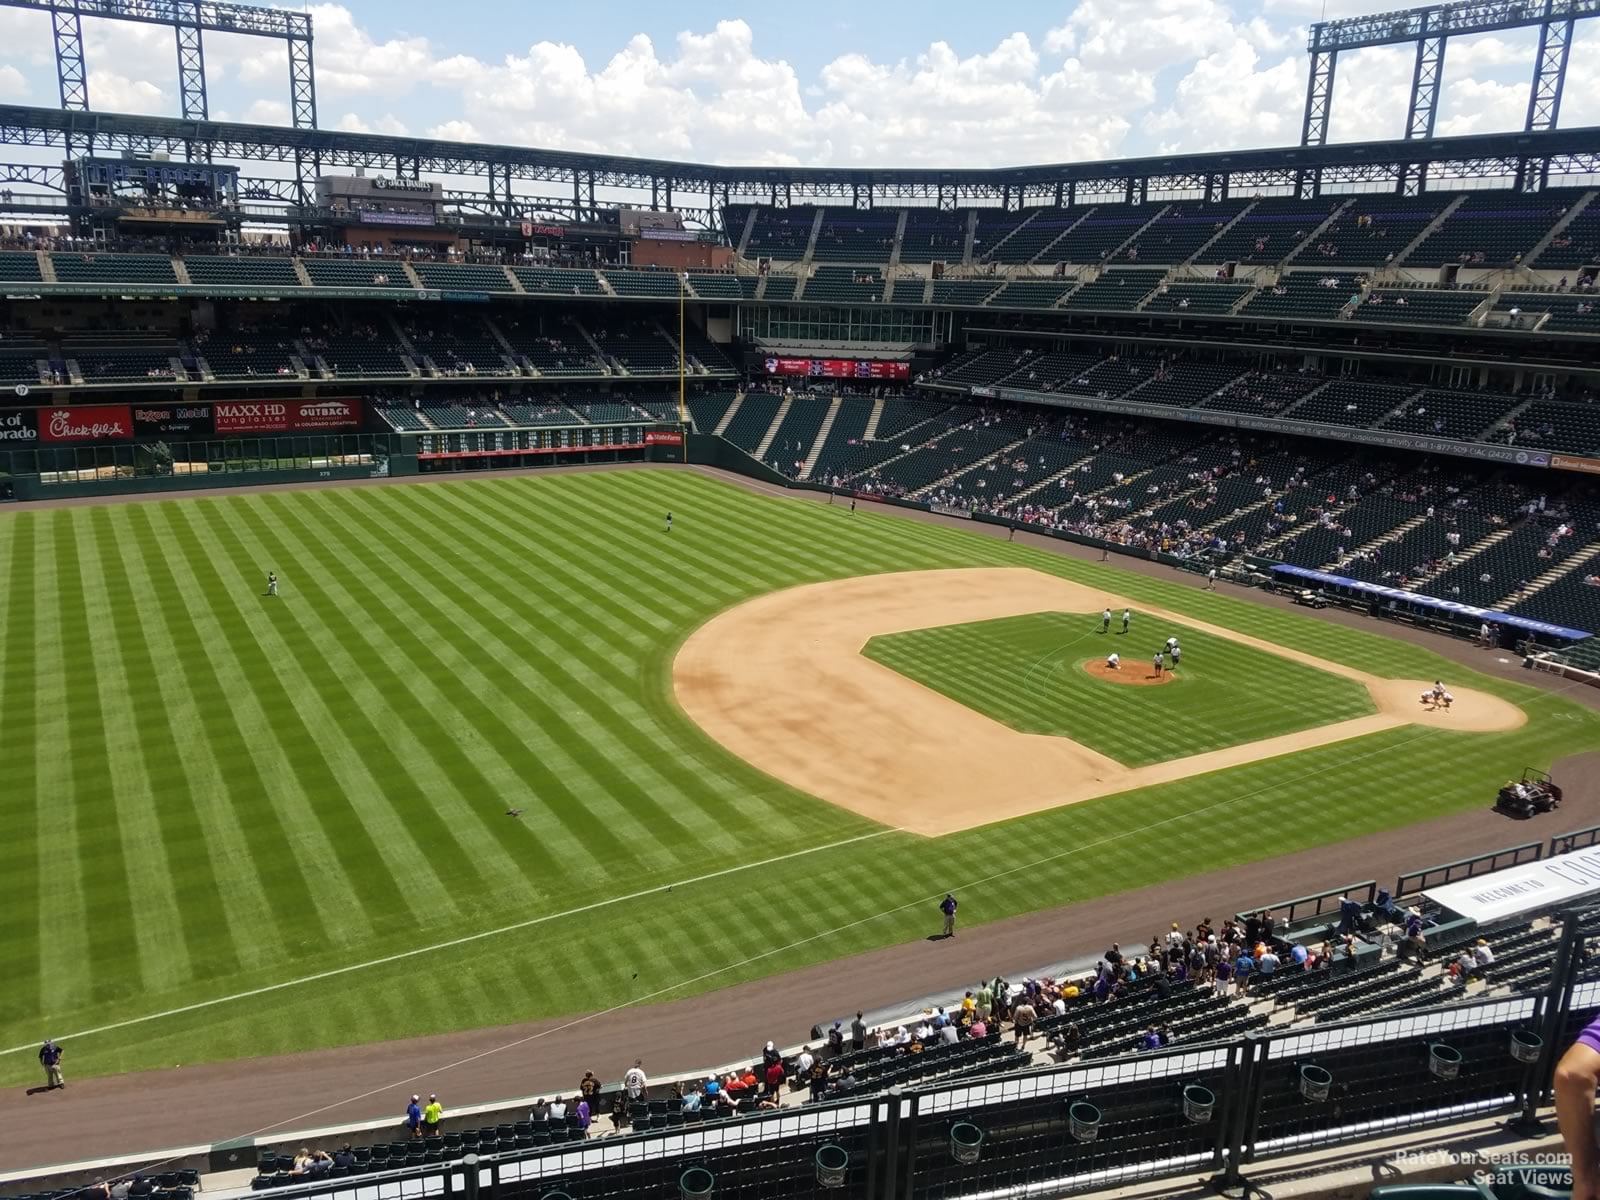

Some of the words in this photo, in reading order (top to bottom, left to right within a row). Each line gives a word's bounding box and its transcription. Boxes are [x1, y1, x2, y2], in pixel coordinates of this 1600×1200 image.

[136, 410, 170, 422] Exxon
[176, 408, 209, 418] Mobil
[216, 405, 262, 417] MAXX
[264, 404, 286, 415] HD
[300, 408, 350, 416] OUTBACK
[7, 413, 22, 426] of
[50, 411, 124, 437] Chick-fil-A
[217, 416, 286, 424] sunglasses
[1472, 883, 1529, 904] WELCOME
[1523, 879, 1545, 889] TO
